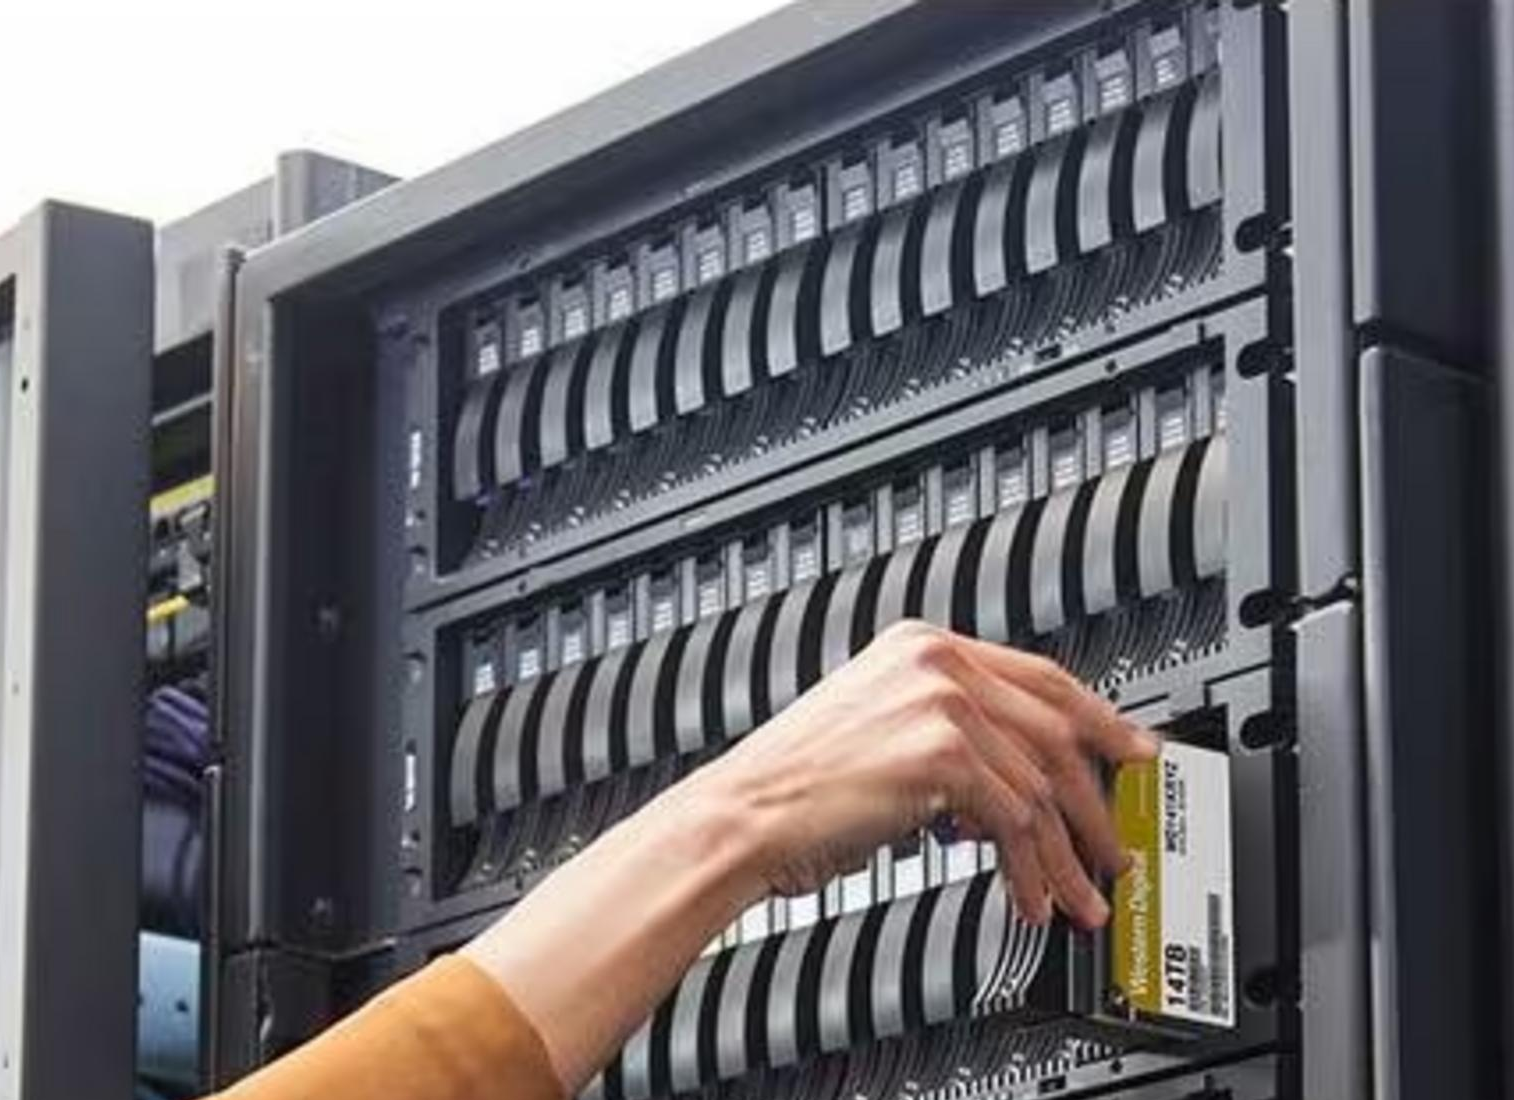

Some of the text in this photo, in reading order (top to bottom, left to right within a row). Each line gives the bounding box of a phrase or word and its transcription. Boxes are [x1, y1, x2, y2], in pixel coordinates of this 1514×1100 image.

[1128, 848, 1153, 997] Western Digital
[1165, 943, 1188, 1006] 14TB
